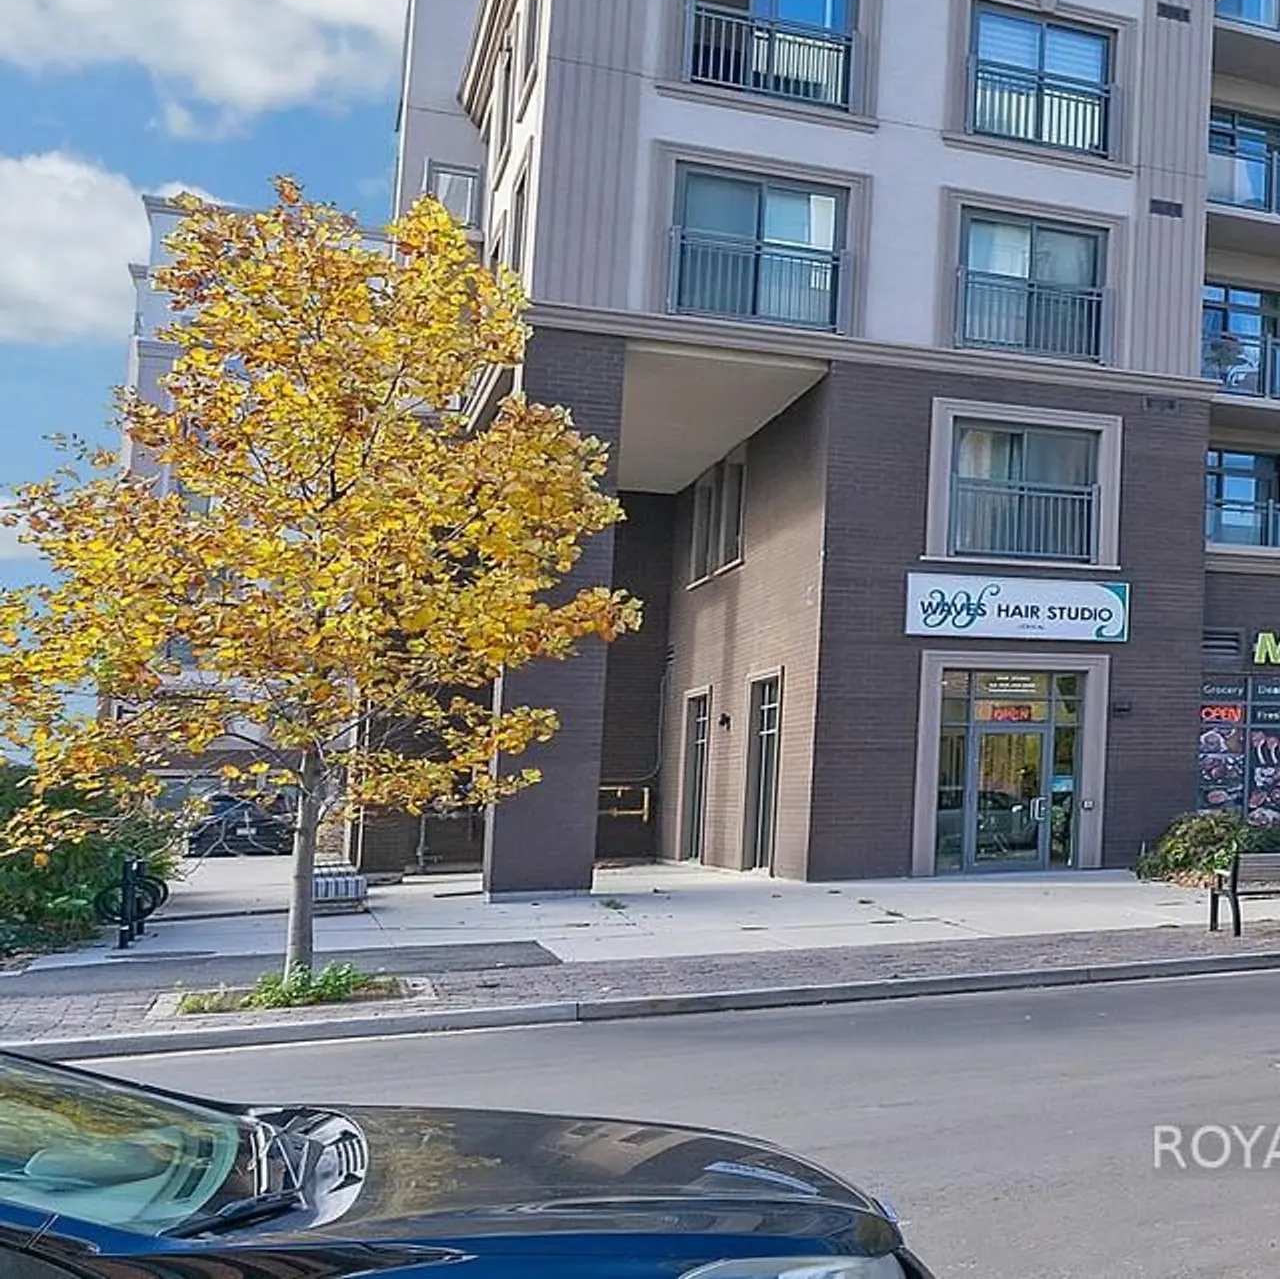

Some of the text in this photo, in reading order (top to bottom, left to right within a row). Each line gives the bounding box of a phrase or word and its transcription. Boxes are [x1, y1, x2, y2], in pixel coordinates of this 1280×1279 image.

[920, 600, 1113, 623] WAVES HAIR STUDIO
[1202, 684, 1244, 696] Grocery
[1201, 706, 1242, 722] OPEN
